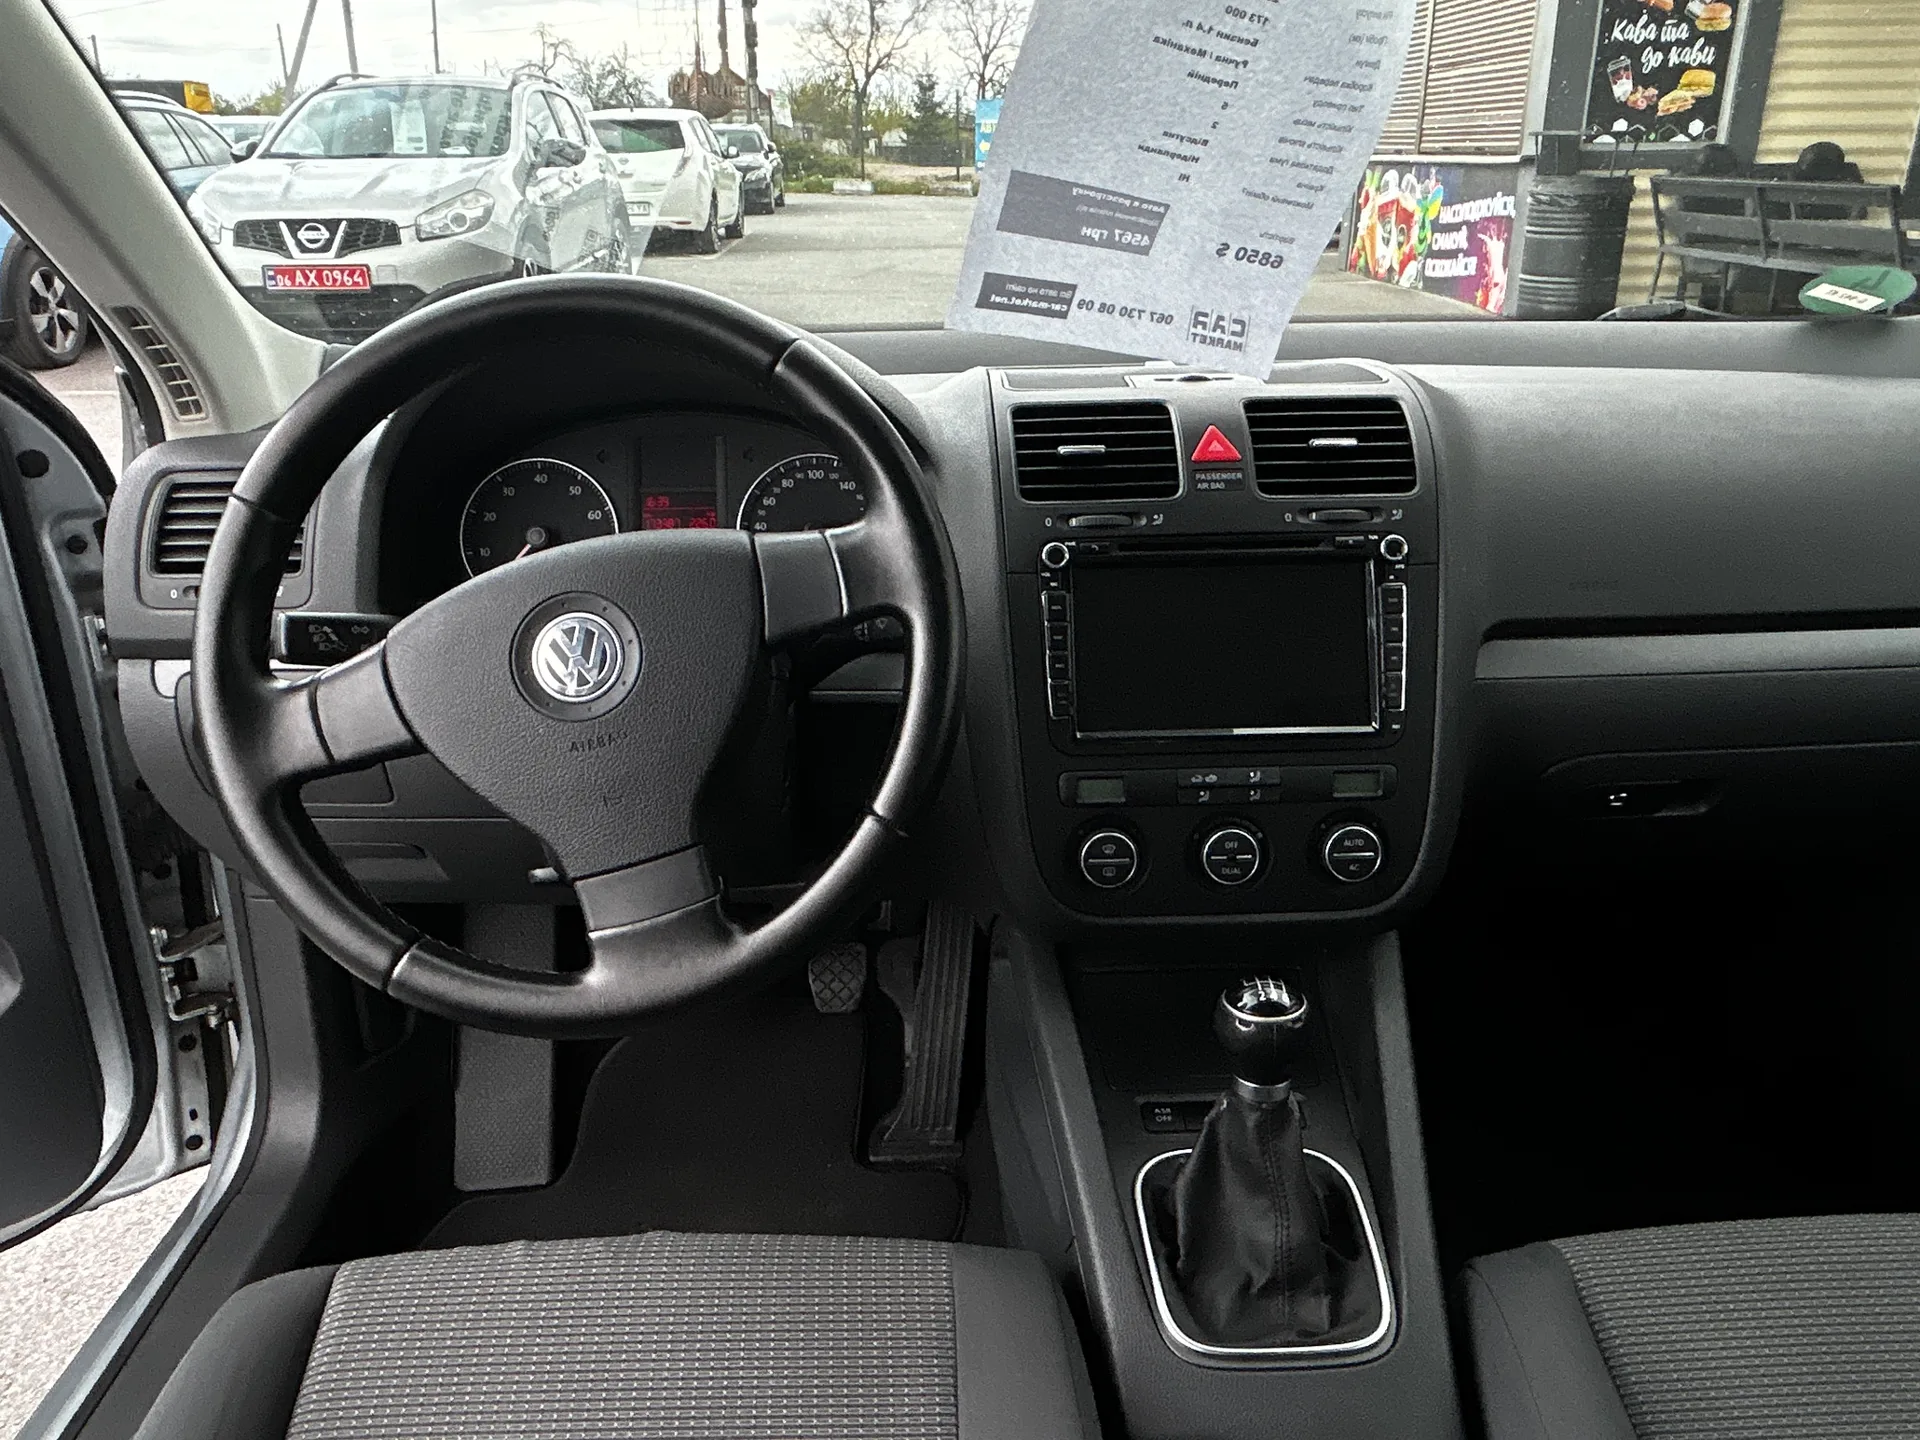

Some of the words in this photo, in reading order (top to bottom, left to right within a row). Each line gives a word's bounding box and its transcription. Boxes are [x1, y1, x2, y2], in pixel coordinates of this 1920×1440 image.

[1610, 13, 1658, 44] Кава
[1668, 36, 1716, 67] кави
[276, 274, 291, 287] 06
[295, 270, 319, 287] AX
[322, 269, 364, 287] 0964
[534, 474, 548, 483] 40
[807, 470, 824, 479] 100
[782, 479, 794, 488] 80
[839, 481, 856, 491] 140
[503, 487, 515, 496] 30
[569, 486, 581, 495] 50
[762, 497, 776, 506] 60
[483, 512, 497, 521] 20
[587, 510, 602, 520] 60
[755, 522, 767, 531] 40
[480, 548, 491, 557] 10
[1225, 840, 1239, 849] OFF
[1343, 838, 1365, 847] AUTO
